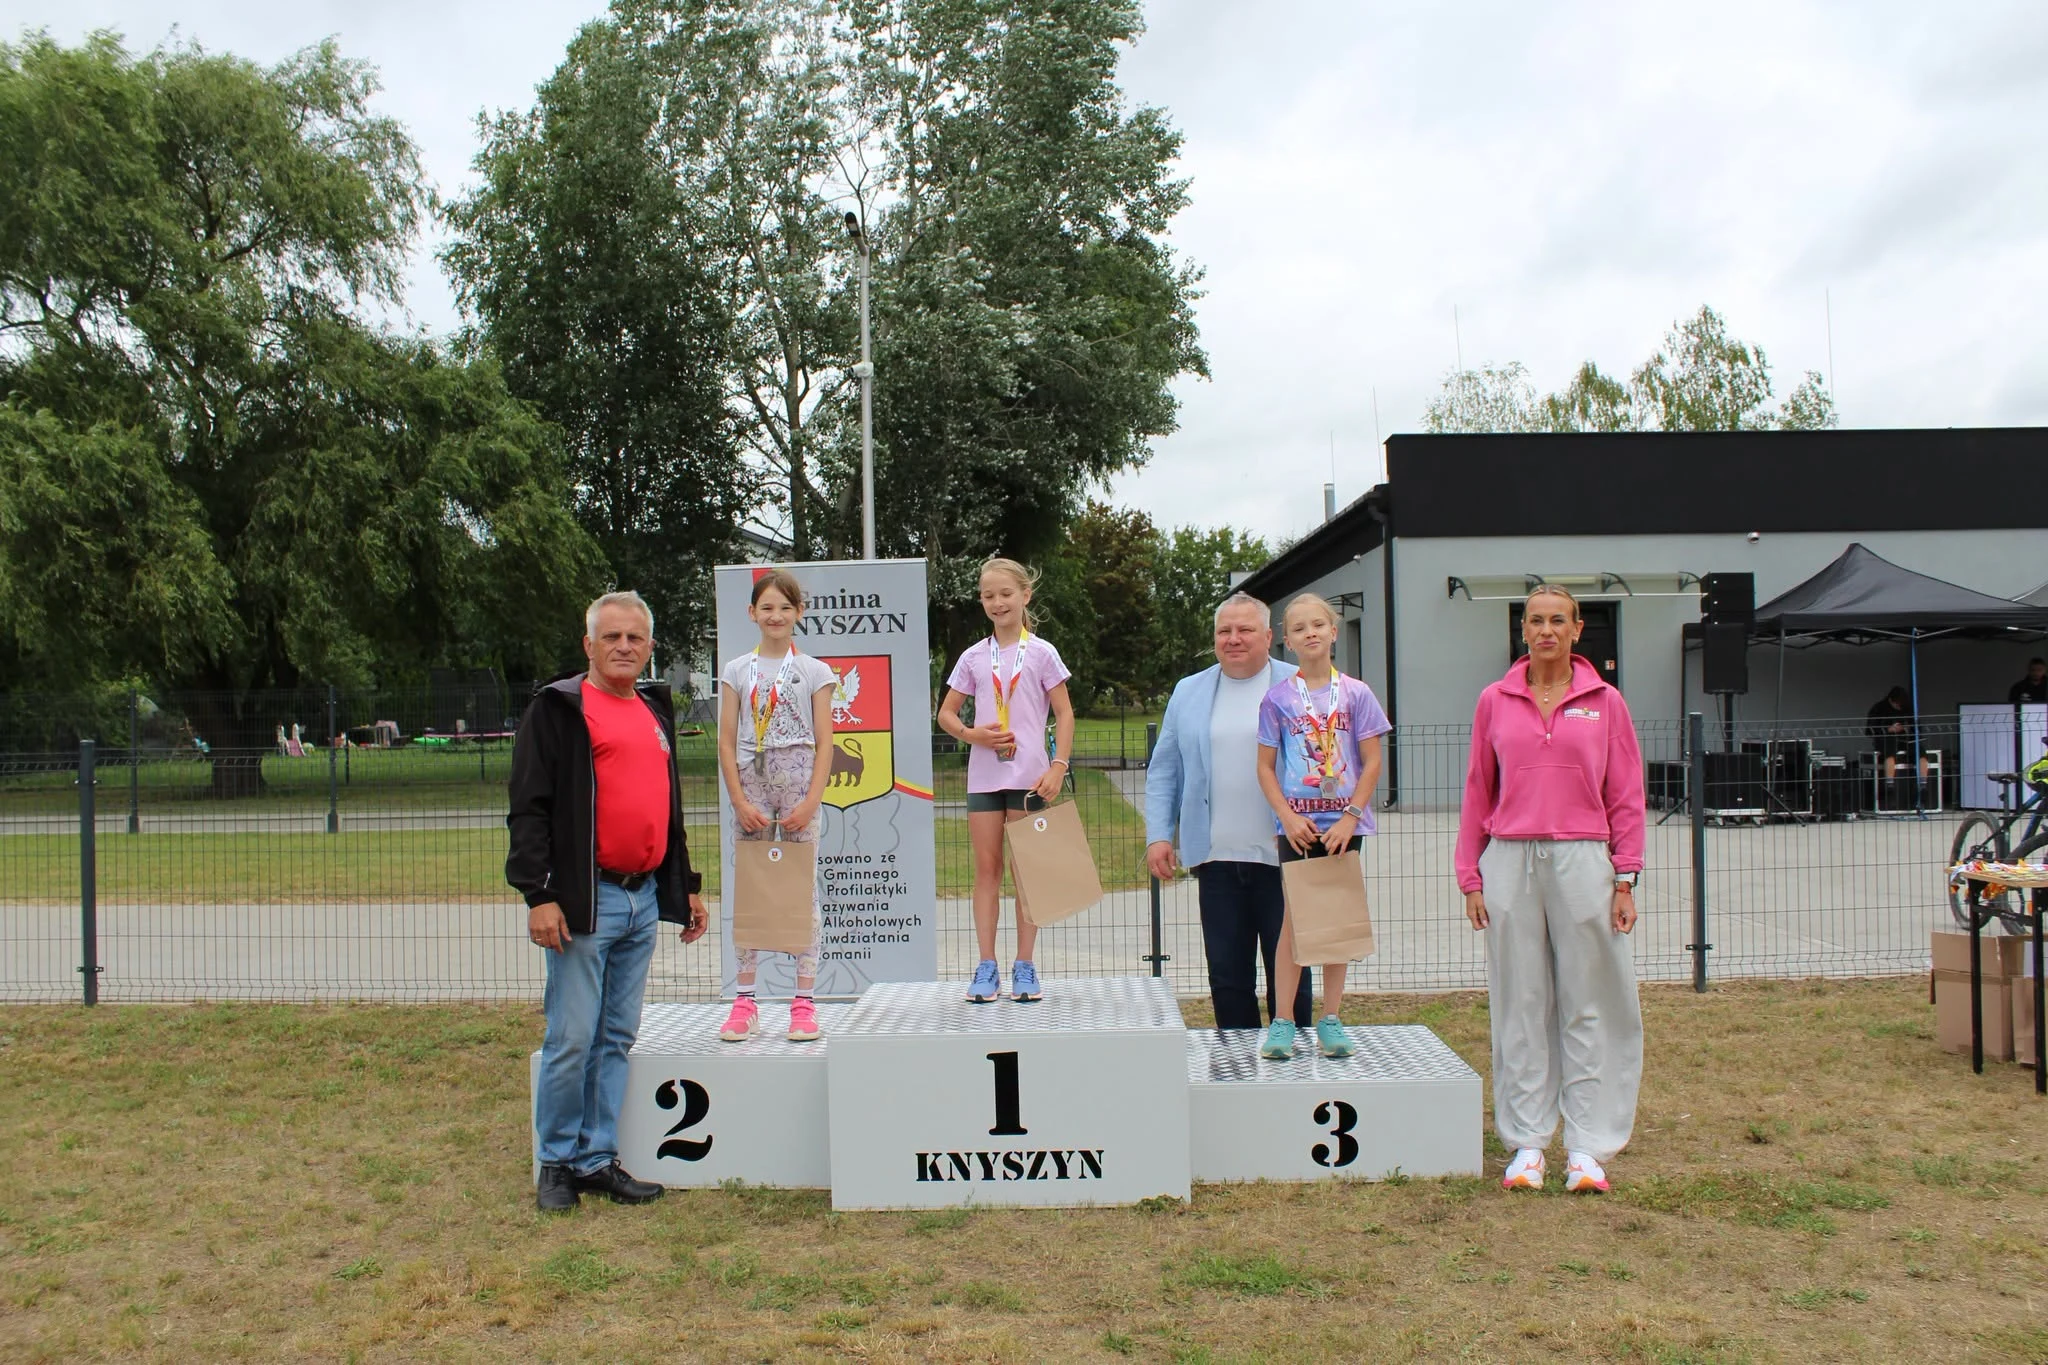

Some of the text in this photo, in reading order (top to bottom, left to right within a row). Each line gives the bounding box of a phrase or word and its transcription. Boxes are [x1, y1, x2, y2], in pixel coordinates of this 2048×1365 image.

[817, 854, 896, 865] sowano ze
[823, 868, 899, 882] Gminnego
[827, 882, 907, 898] Profilaktyki
[823, 914, 922, 930] Alkoholowych
[819, 947, 871, 960] omanii
[986, 1051, 1028, 1136] 1
[655, 1079, 713, 1162] 2
[1311, 1100, 1359, 1167] 3
[915, 1150, 1105, 1182] KNYSZYN
